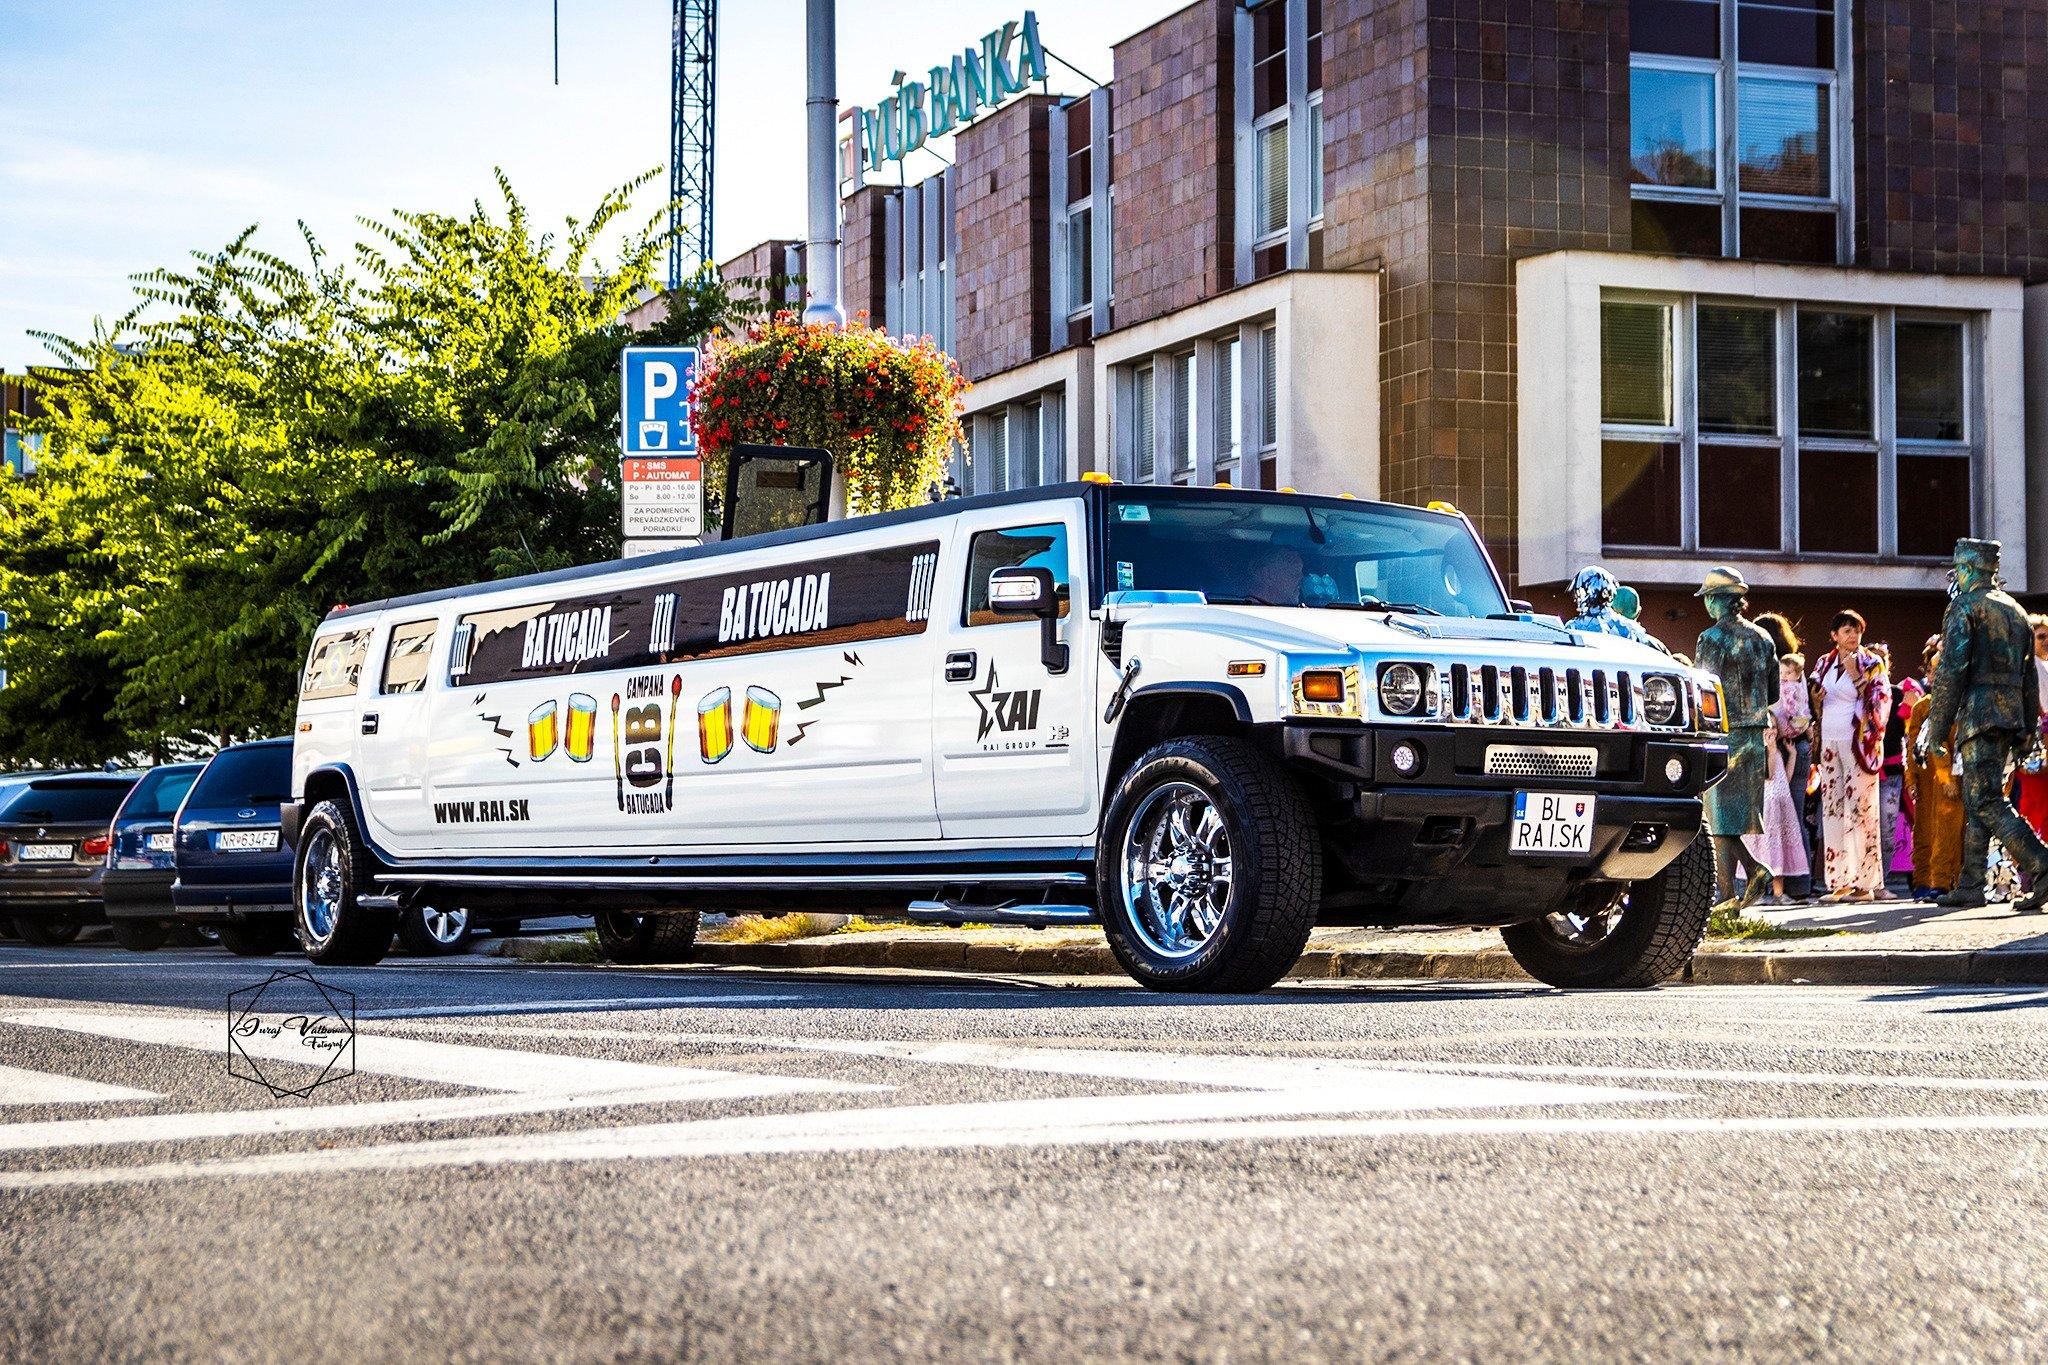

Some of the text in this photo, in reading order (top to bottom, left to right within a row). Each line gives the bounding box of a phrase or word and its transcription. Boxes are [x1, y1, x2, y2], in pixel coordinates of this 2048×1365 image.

[864, 10, 1049, 172] VÚB BANKA
[644, 361, 677, 420] P
[632, 461, 640, 470] P
[646, 461, 667, 470] SMS
[632, 471, 640, 480] P
[646, 471, 691, 480] AUTOMAT
[634, 507, 691, 515] ZA PODMIENOK
[643, 525, 682, 533] PORIADKU
[718, 572, 831, 643] BATUCADA
[521, 605, 612, 668] BATUCADA
[626, 674, 664, 700] CAMPANA
[1471, 684, 1618, 699] HUMMER
[983, 741, 1037, 751] RAI GROUP
[434, 799, 530, 824] WWW.RAI.SK
[625, 793, 665, 815] BATUCADA
[1542, 796, 1566, 821] BL
[221, 831, 277, 848] NR 634FZ
[1518, 822, 1586, 848] RAI.SK
